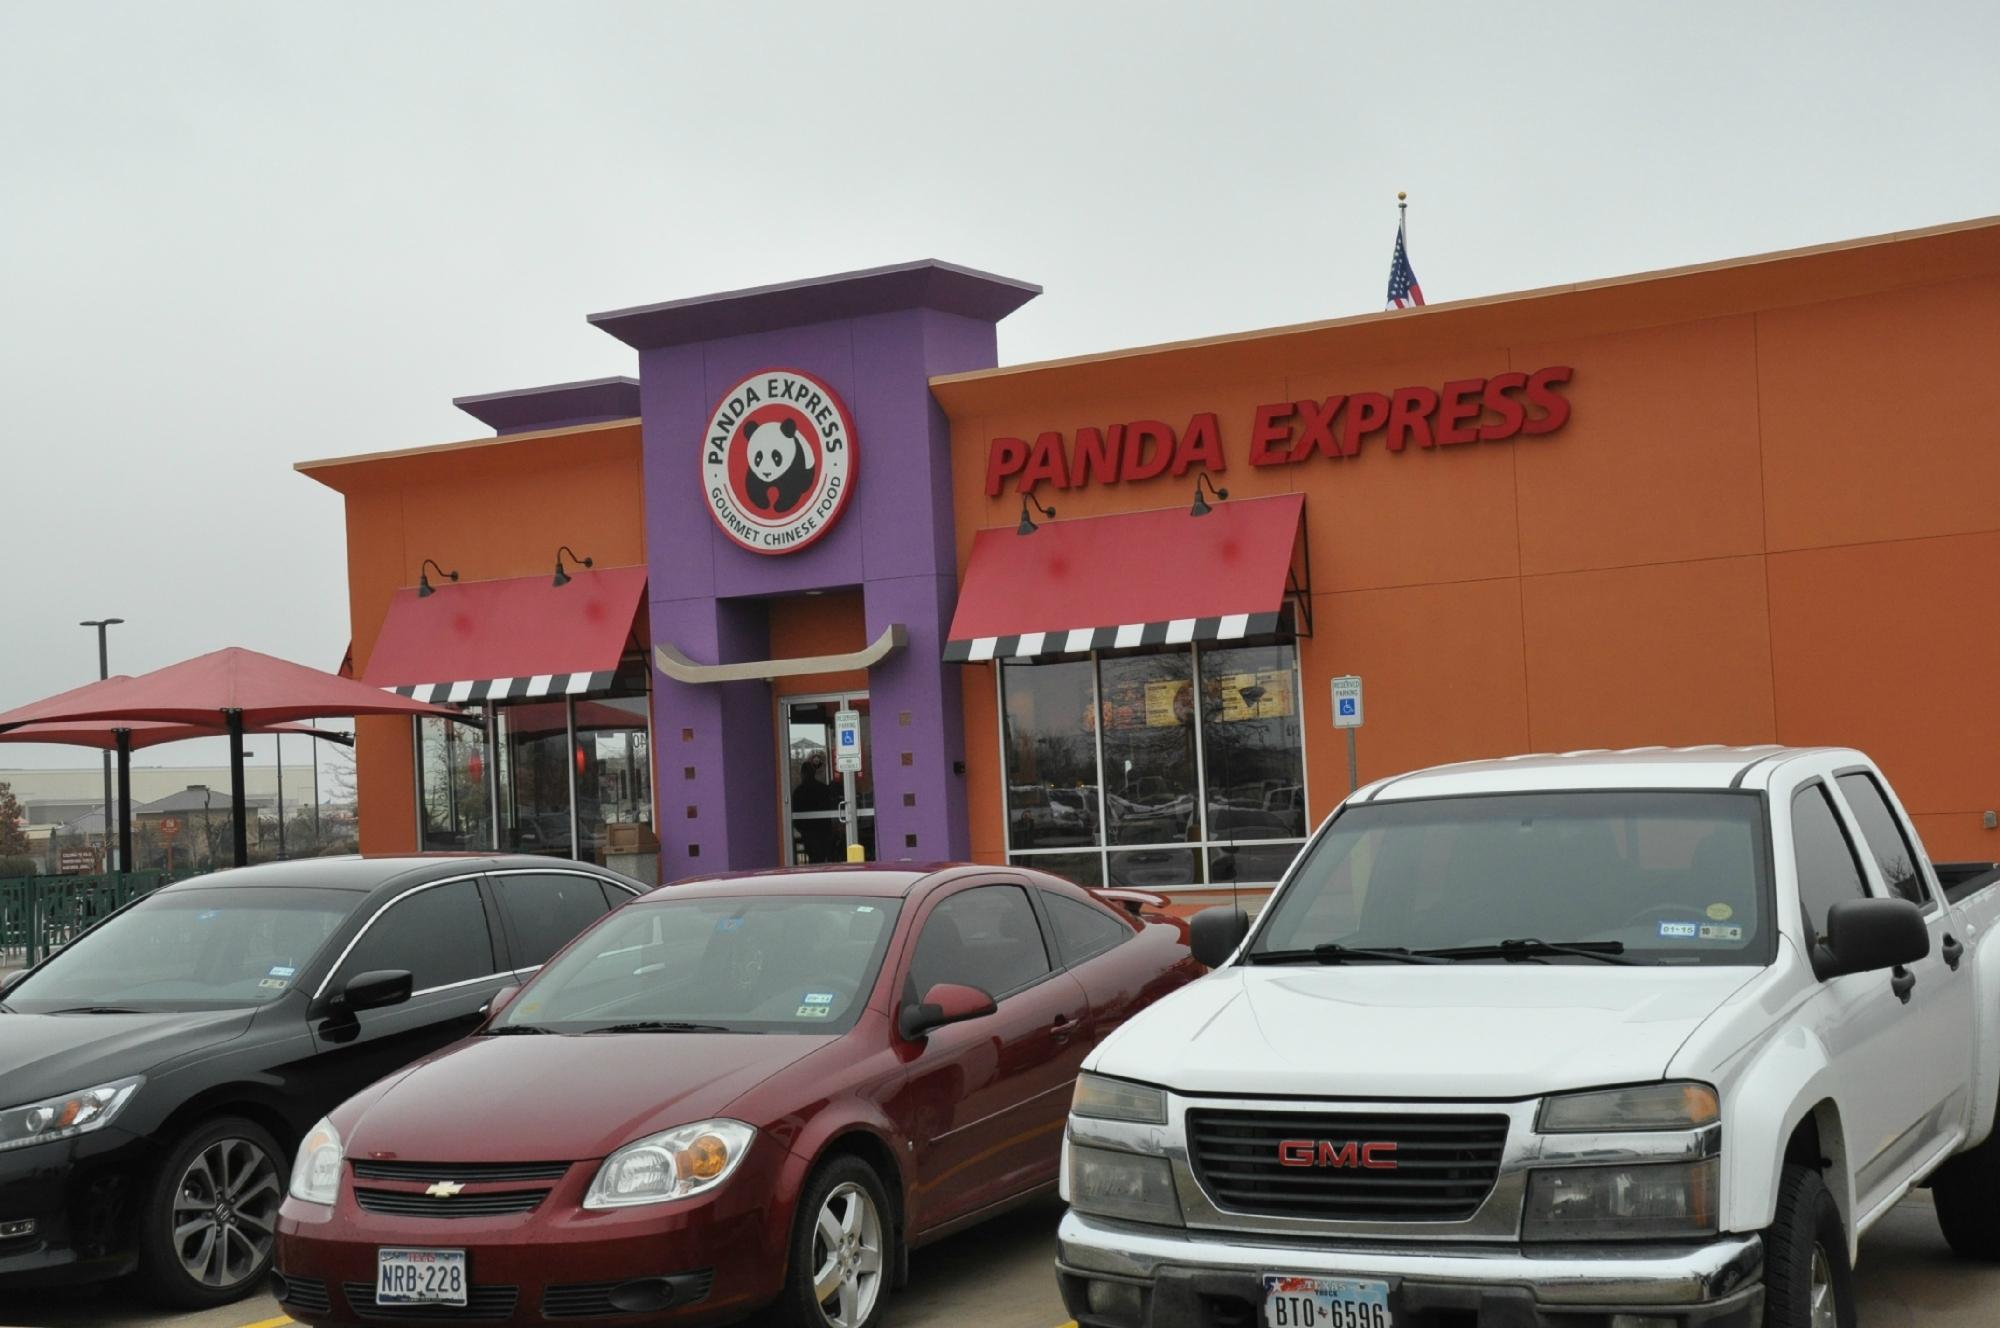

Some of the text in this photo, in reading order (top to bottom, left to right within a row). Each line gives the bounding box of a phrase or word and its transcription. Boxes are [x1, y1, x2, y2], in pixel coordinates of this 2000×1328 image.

[708, 378, 843, 465] PANDA EXPRESS
[985, 365, 1574, 497] PANDA EXPRESS
[711, 476, 841, 546] GOURMET CHINESE FOOD
[1335, 689, 1359, 697] PARKING
[1278, 1139, 1398, 1169] GMC
[408, 1252, 436, 1264] TEXAS
[381, 1264, 462, 1293] NRB 228
[1303, 1280, 1346, 1291] TEXAS
[1314, 1289, 1338, 1297] TRUCK
[1331, 1299, 1384, 1328] 6596
